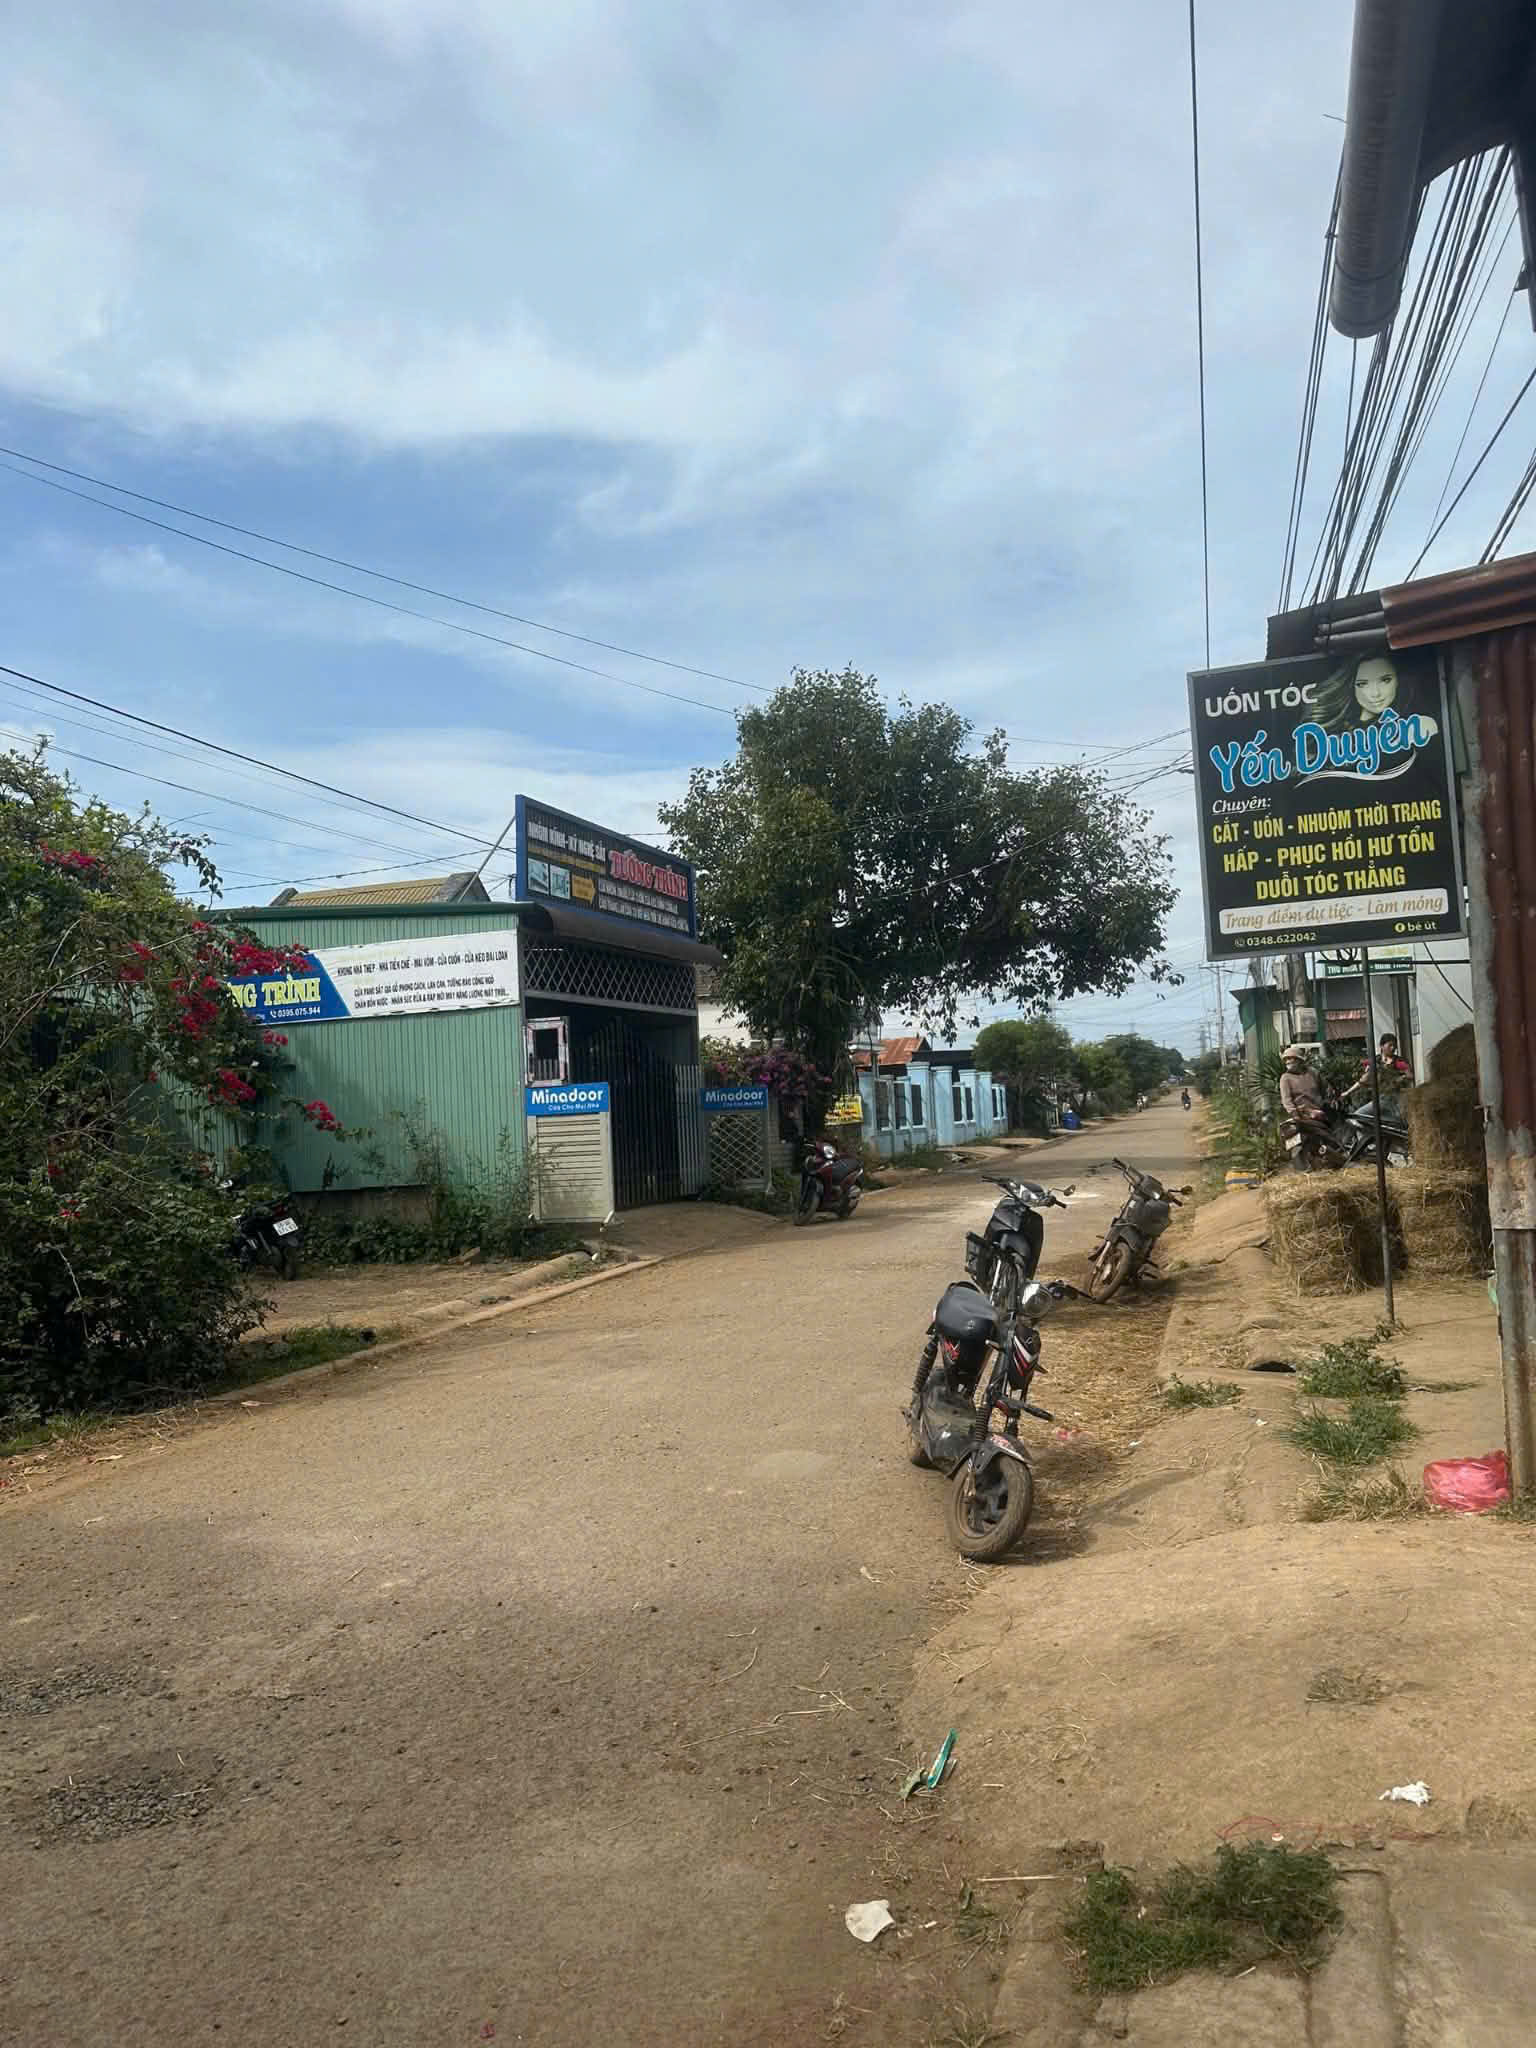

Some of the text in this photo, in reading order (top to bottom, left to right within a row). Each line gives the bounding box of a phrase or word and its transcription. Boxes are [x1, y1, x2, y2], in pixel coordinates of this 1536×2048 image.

[1205, 682, 1318, 717] UỐN TÓC
[1209, 707, 1432, 792] Yến Duyên
[1212, 797, 1271, 814] Chuyên:
[1213, 817, 1240, 843] CẮT
[1253, 812, 1284, 839] UỐN
[1297, 806, 1351, 835] NHUỘM
[1355, 801, 1389, 827] THỜI
[1392, 800, 1442, 823] TRANG
[1224, 845, 1259, 872] HẤP
[1277, 843, 1326, 868] PHỤC
[1332, 833, 1363, 861] HỒI
[1368, 834, 1394, 857] HƯ
[1398, 825, 1435, 854] TỔN
[1256, 860, 1406, 900] DUỖI TÓC THẲNG
[1224, 913, 1264, 930] Trang
[1368, 899, 1398, 915] Làm
[1402, 896, 1443, 913] móng
[1247, 932, 1316, 946] 0348.622042
[262, 973, 321, 1006] TRÌNH
[532, 1088, 603, 1104] Minadoor
[705, 1089, 763, 1103] Minadoor
